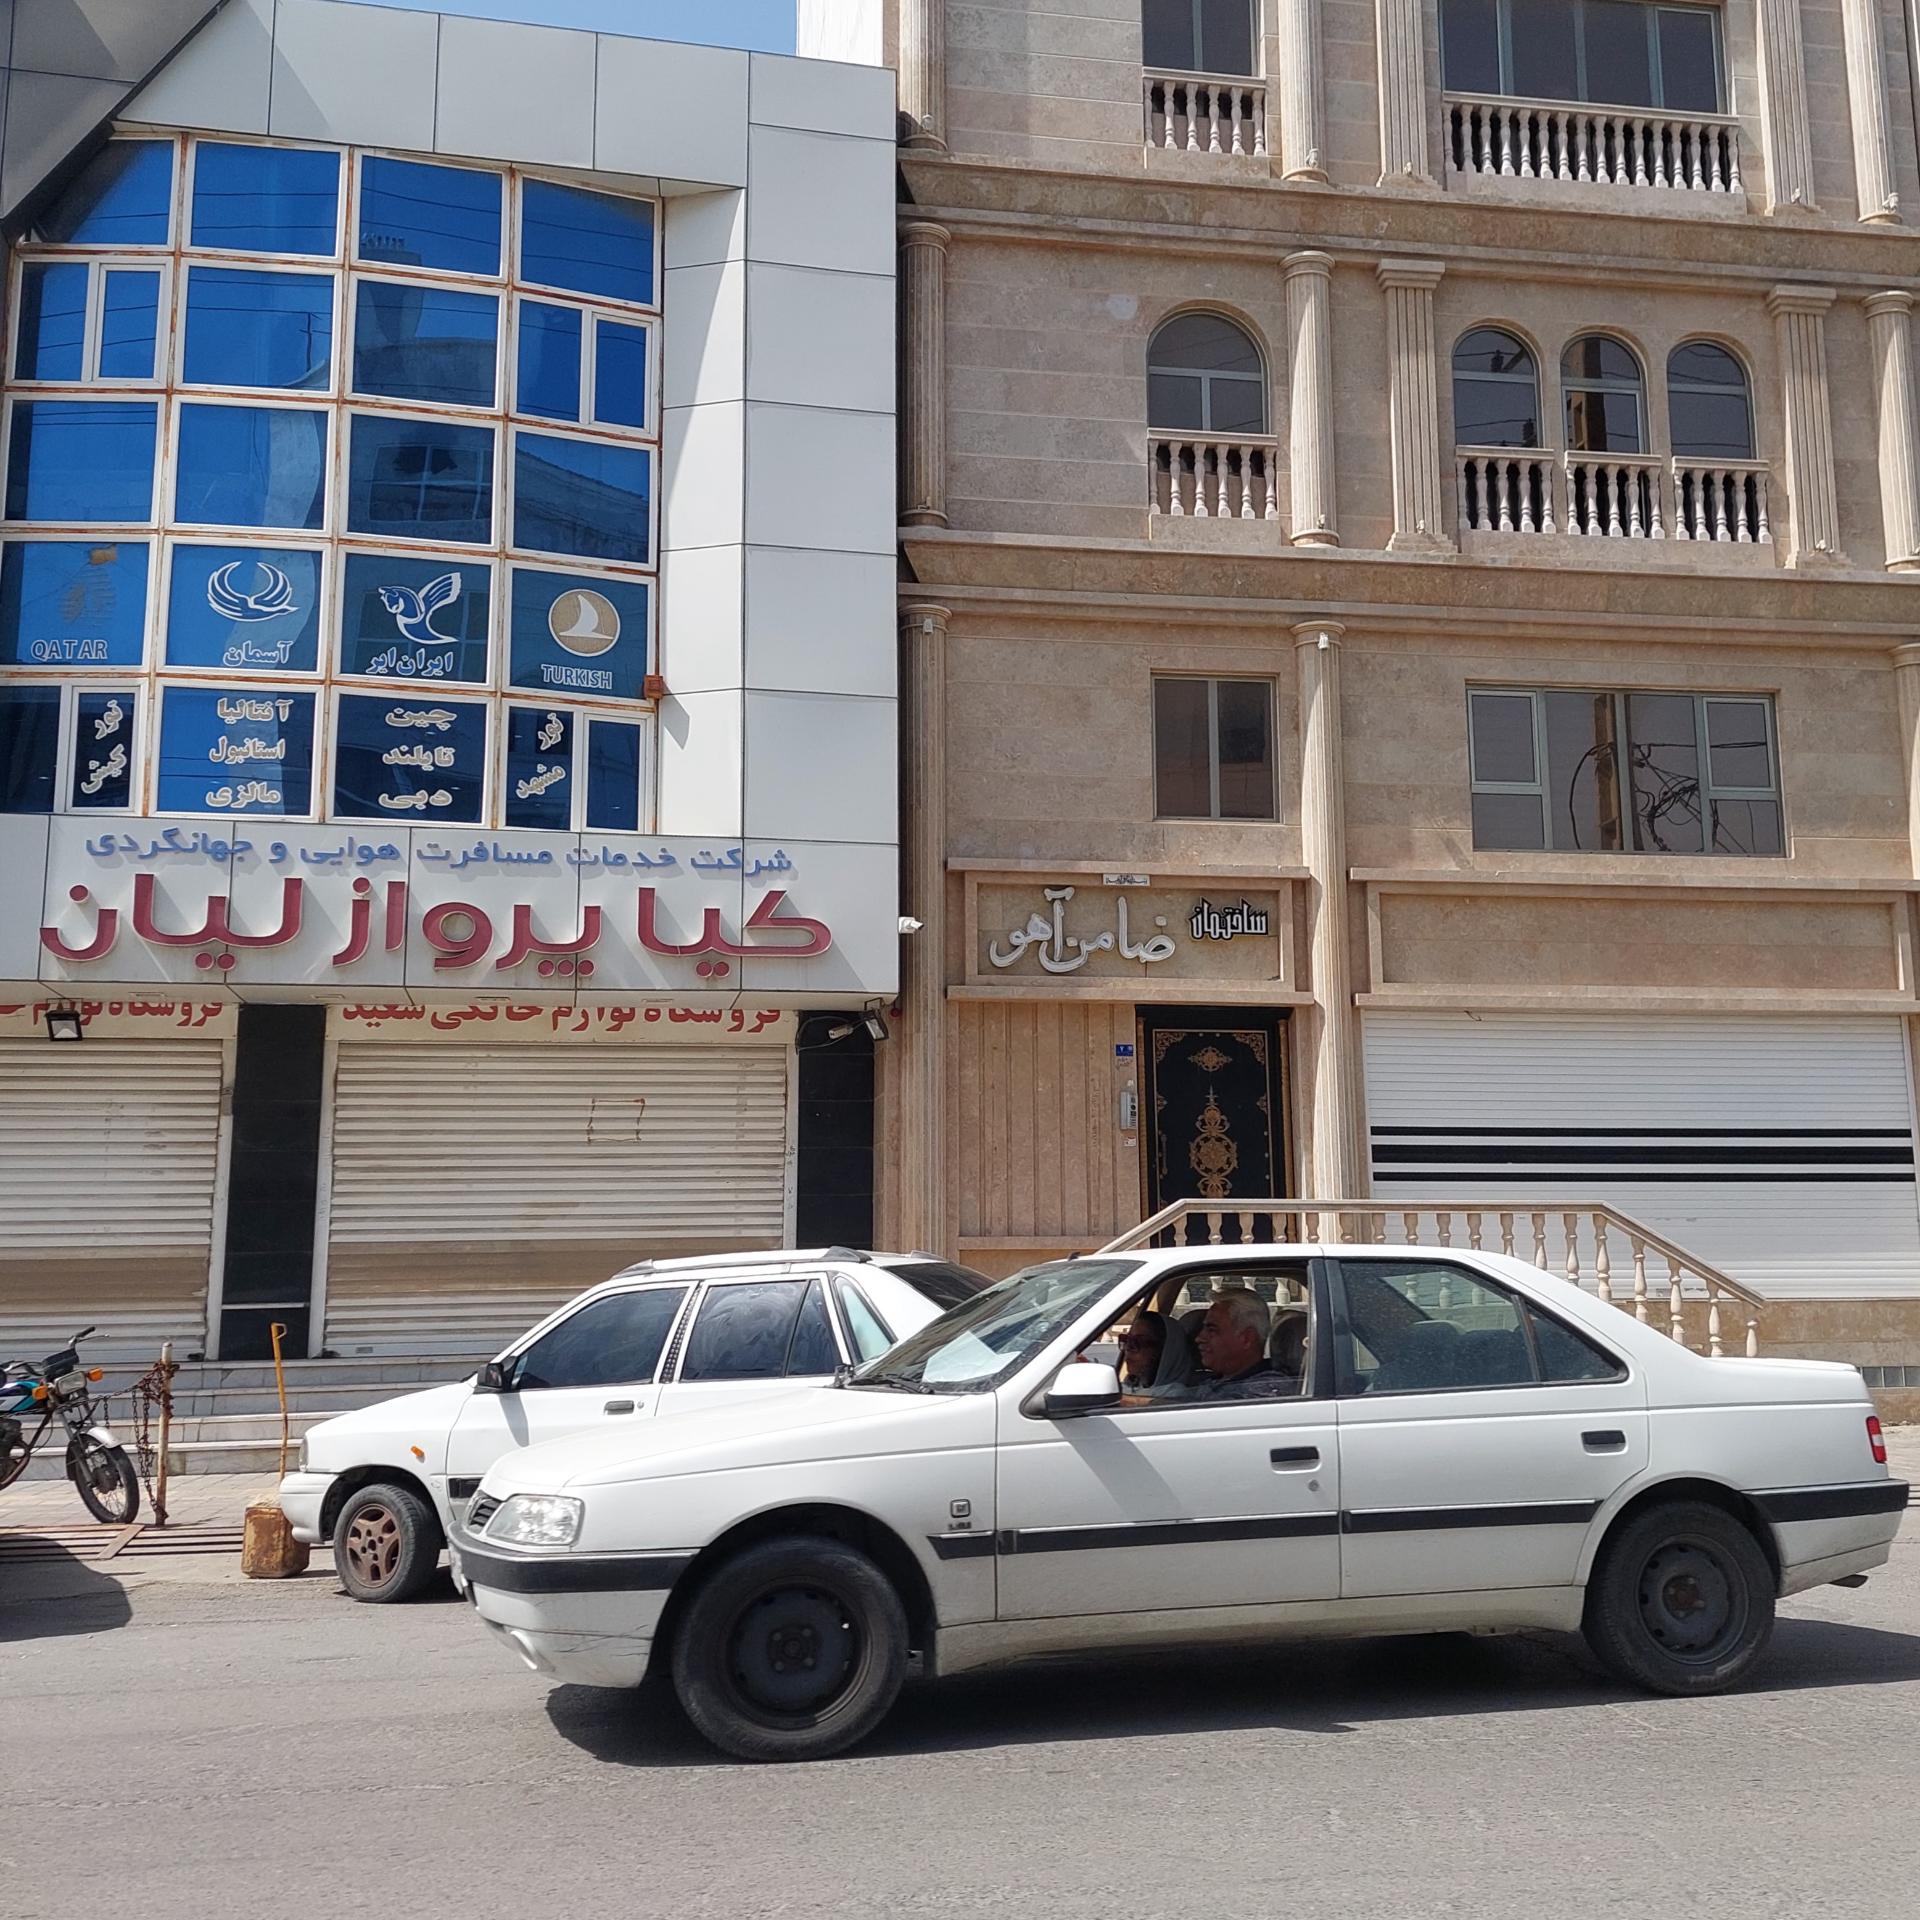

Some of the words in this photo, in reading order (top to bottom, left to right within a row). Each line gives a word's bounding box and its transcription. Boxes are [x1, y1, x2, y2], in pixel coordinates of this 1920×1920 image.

[31, 640, 108, 661] QATAR
[223, 641, 293, 667] آسمان
[366, 647, 397, 675] ایر
[396, 648, 454, 676] ایران
[541, 664, 613, 689] TURKISH
[95, 700, 123, 740] تور
[385, 707, 457, 730] چین
[538, 713, 564, 750] تور
[209, 736, 286, 764] استانبول
[382, 745, 455, 771] تایلند
[81, 744, 127, 794] کیش
[516, 764, 566, 799] مشهد
[206, 781, 281, 808] مالزی
[378, 789, 452, 810] دبی
[86, 828, 252, 863] جهانگردی
[269, 842, 288, 863] و
[300, 837, 401, 866] هوایی
[416, 841, 553, 868] مسافرت
[566, 846, 677, 868] خدمات
[690, 847, 792, 877] شرکت
[39, 873, 303, 971] لیان
[332, 876, 601, 977] پرواز
[638, 887, 832, 978] کیا
[990, 887, 1075, 967] آهو
[1189, 896, 1269, 941] ساختمان
[1039, 896, 1176, 973] ضامن
